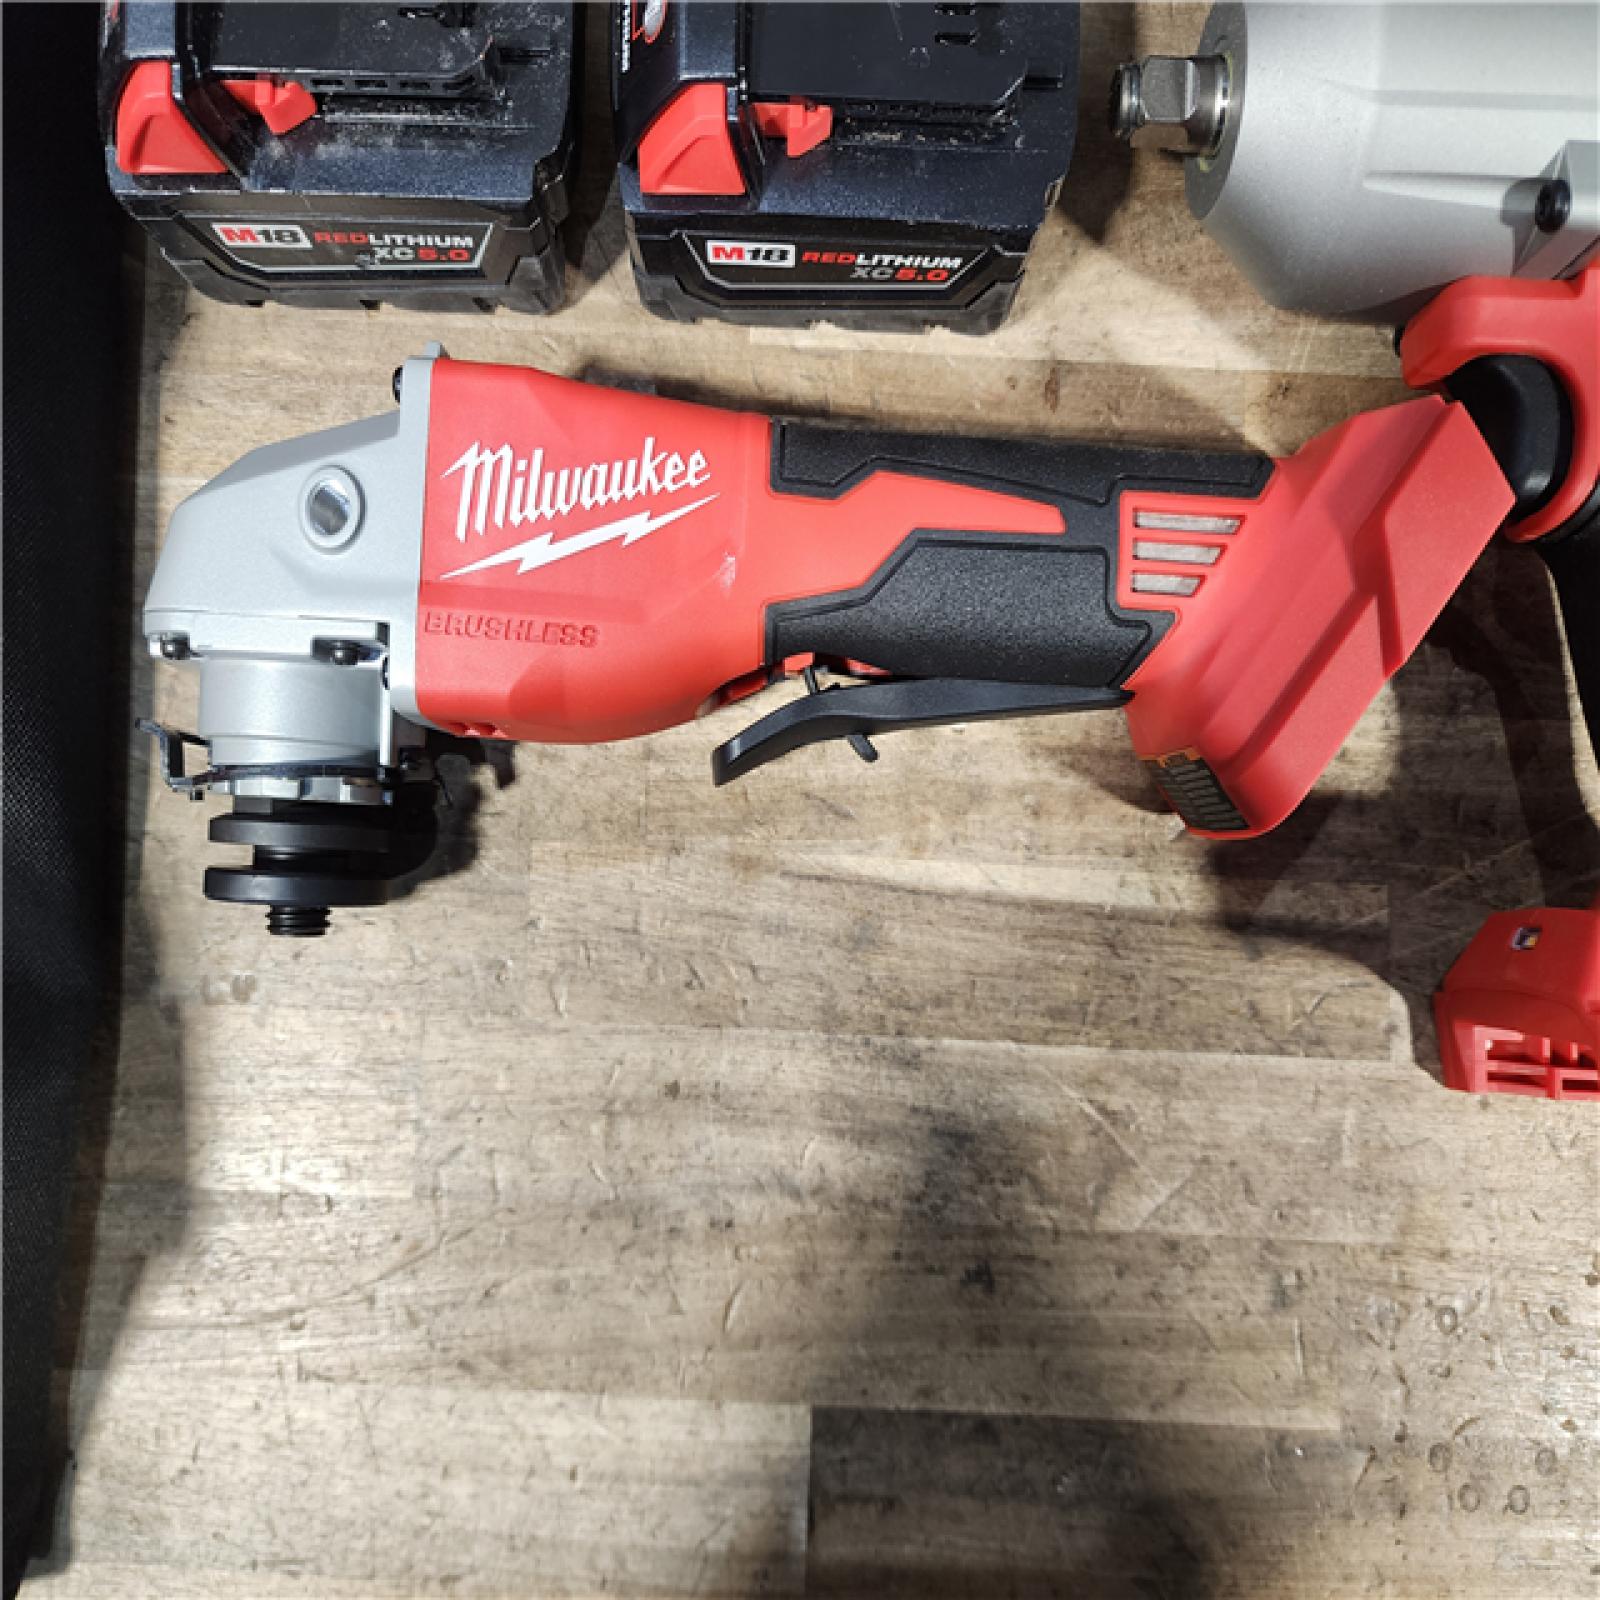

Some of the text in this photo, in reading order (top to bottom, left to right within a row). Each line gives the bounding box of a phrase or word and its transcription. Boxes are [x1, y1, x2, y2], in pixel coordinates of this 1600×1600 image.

[219, 226, 302, 244] M18
[712, 245, 791, 263] M18
[440, 436, 712, 543] Milwaukee
[424, 611, 600, 648] BRUSHLESS
